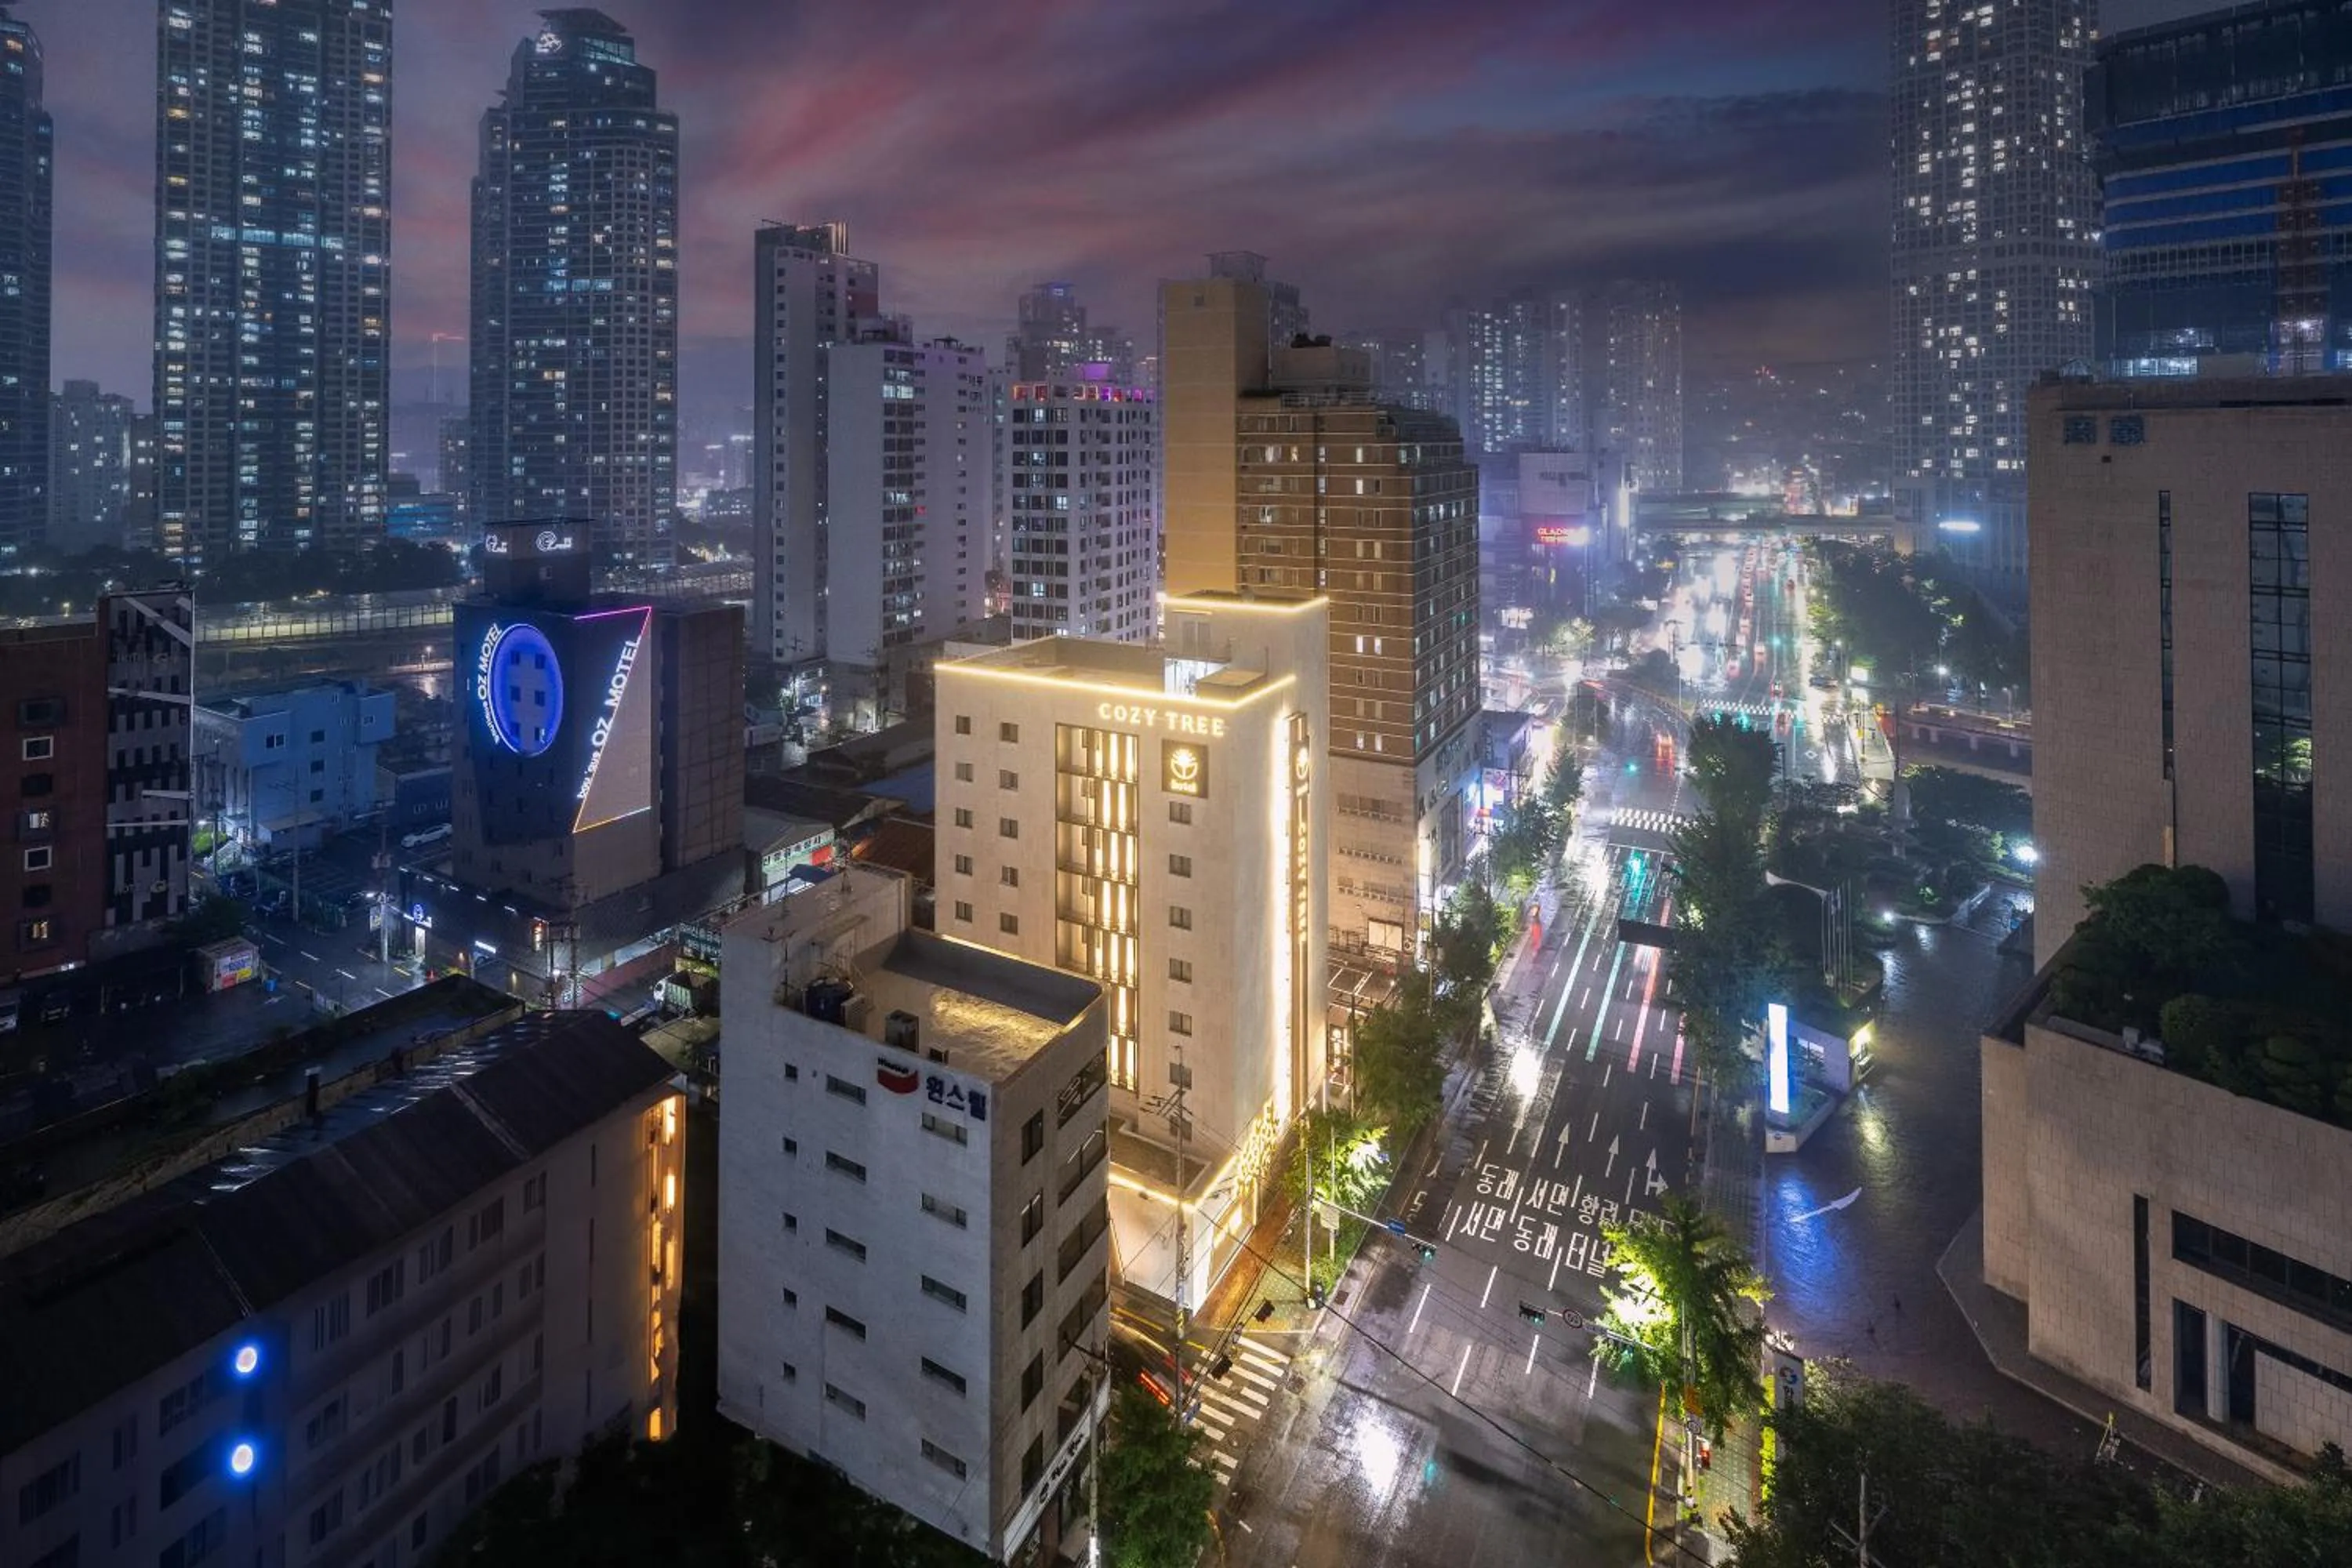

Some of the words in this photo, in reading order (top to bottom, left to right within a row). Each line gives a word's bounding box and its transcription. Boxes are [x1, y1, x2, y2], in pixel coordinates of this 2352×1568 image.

[477, 622, 503, 673] MOTEL
[477, 674, 488, 700] OZ
[592, 717, 612, 747] OZ
[604, 637, 641, 706] MOTEL
[1098, 702, 1157, 727] COZY
[1165, 710, 1225, 737] TREE
[1476, 1163, 1520, 1200] 동래
[1526, 1178, 1570, 1216] 서면
[1460, 1200, 1506, 1243] 서면
[1513, 1215, 1559, 1260] 동래
[1566, 1232, 1613, 1279] 터널
